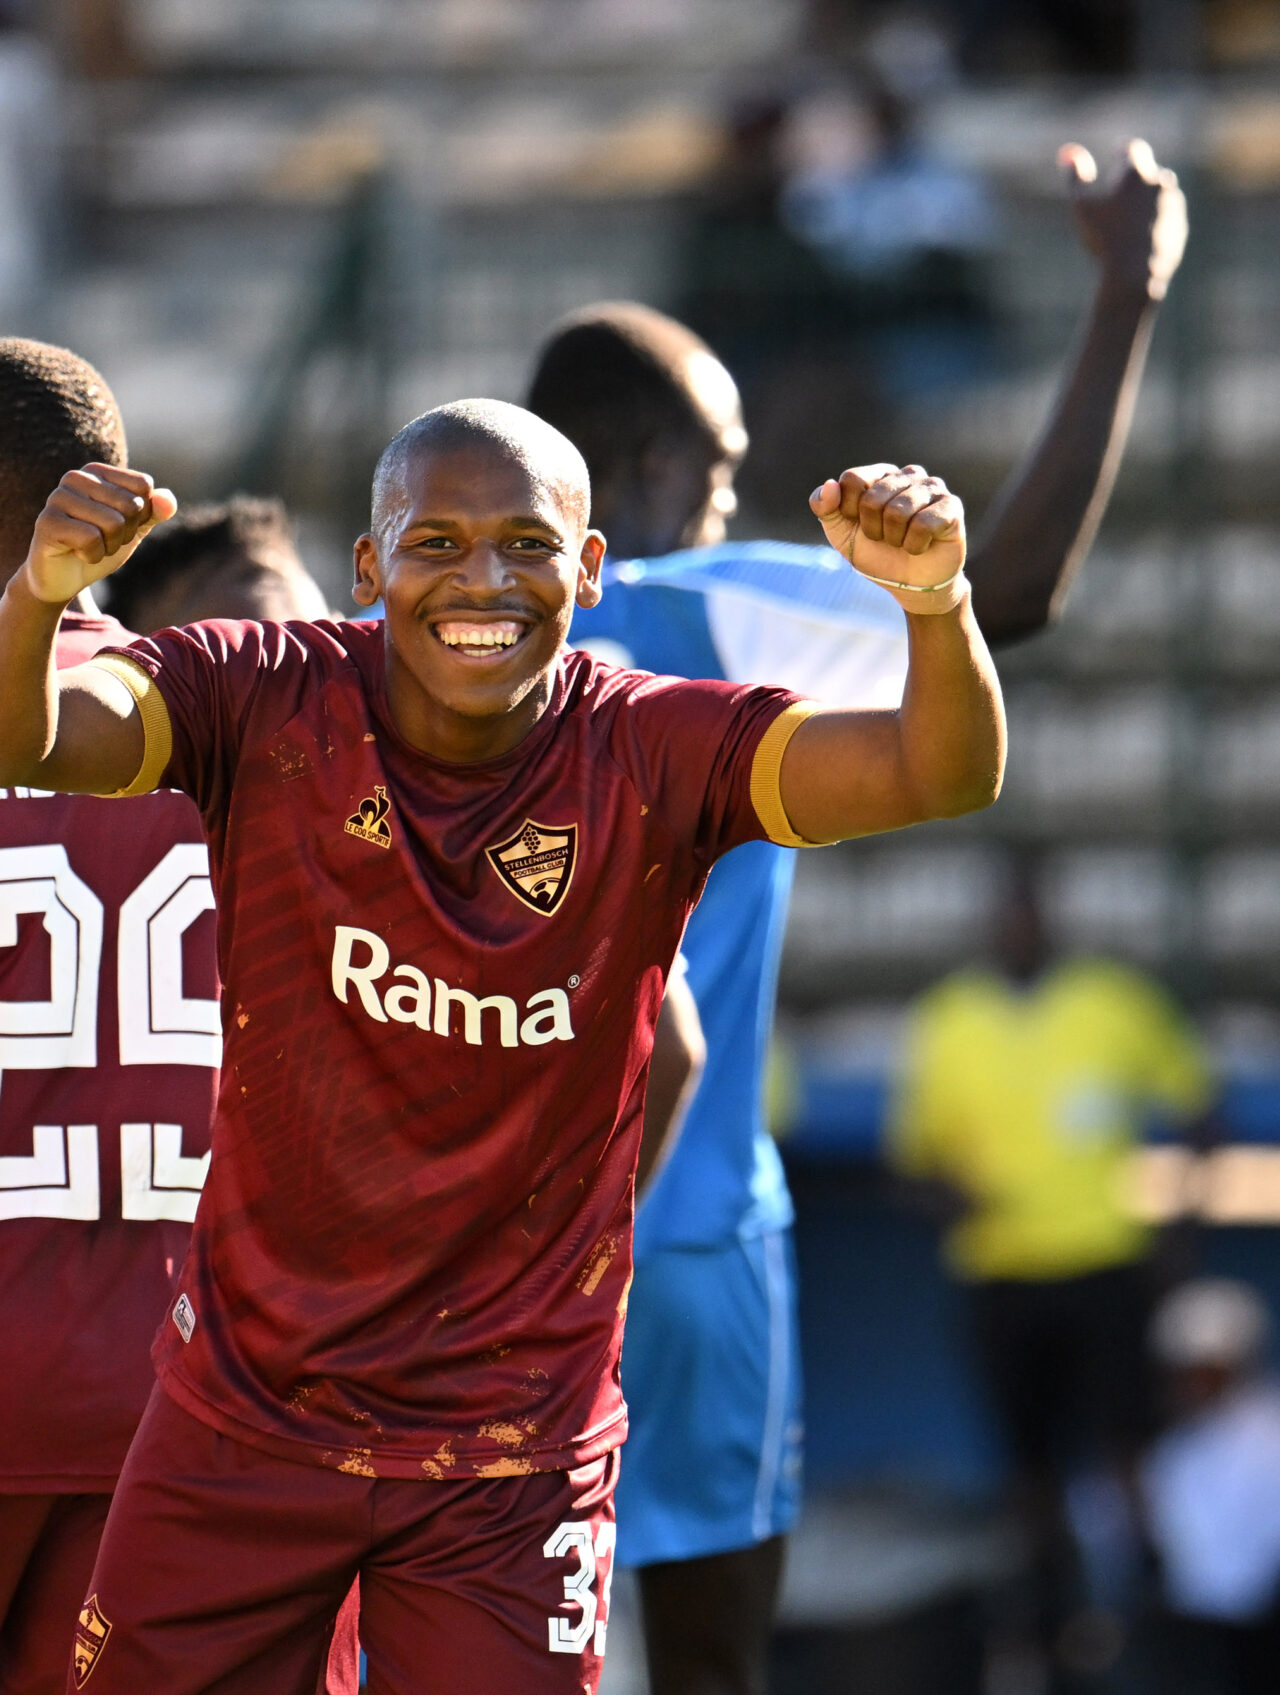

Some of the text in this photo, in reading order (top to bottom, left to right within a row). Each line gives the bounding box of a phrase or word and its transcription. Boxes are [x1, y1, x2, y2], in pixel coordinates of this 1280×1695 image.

[504, 848, 569, 871] STELLENBOSCH
[513, 864, 547, 877] FOOTBALL
[331, 925, 575, 1047] Rama
